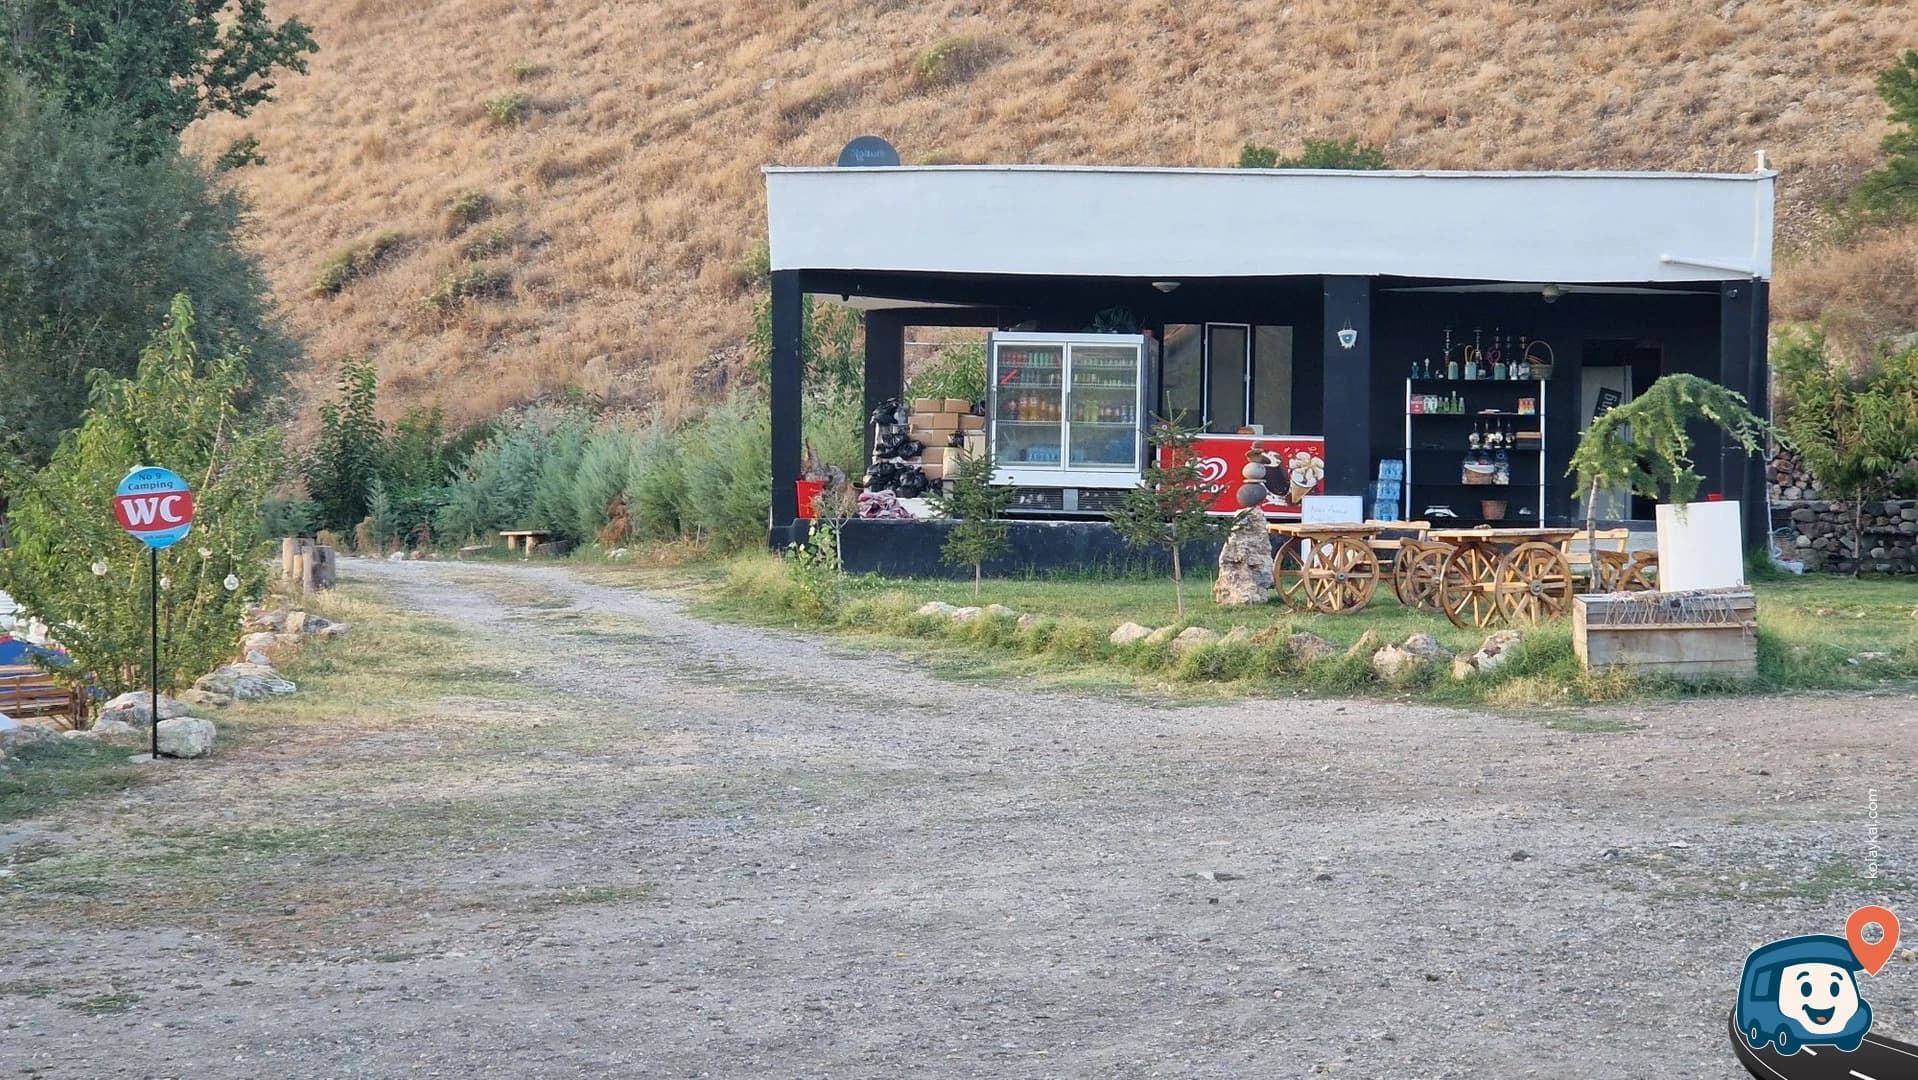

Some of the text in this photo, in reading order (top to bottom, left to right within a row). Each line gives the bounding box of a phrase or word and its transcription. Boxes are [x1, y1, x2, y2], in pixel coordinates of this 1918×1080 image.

[138, 473, 152, 481] No
[127, 480, 173, 490] Camping
[121, 495, 183, 526] WC
